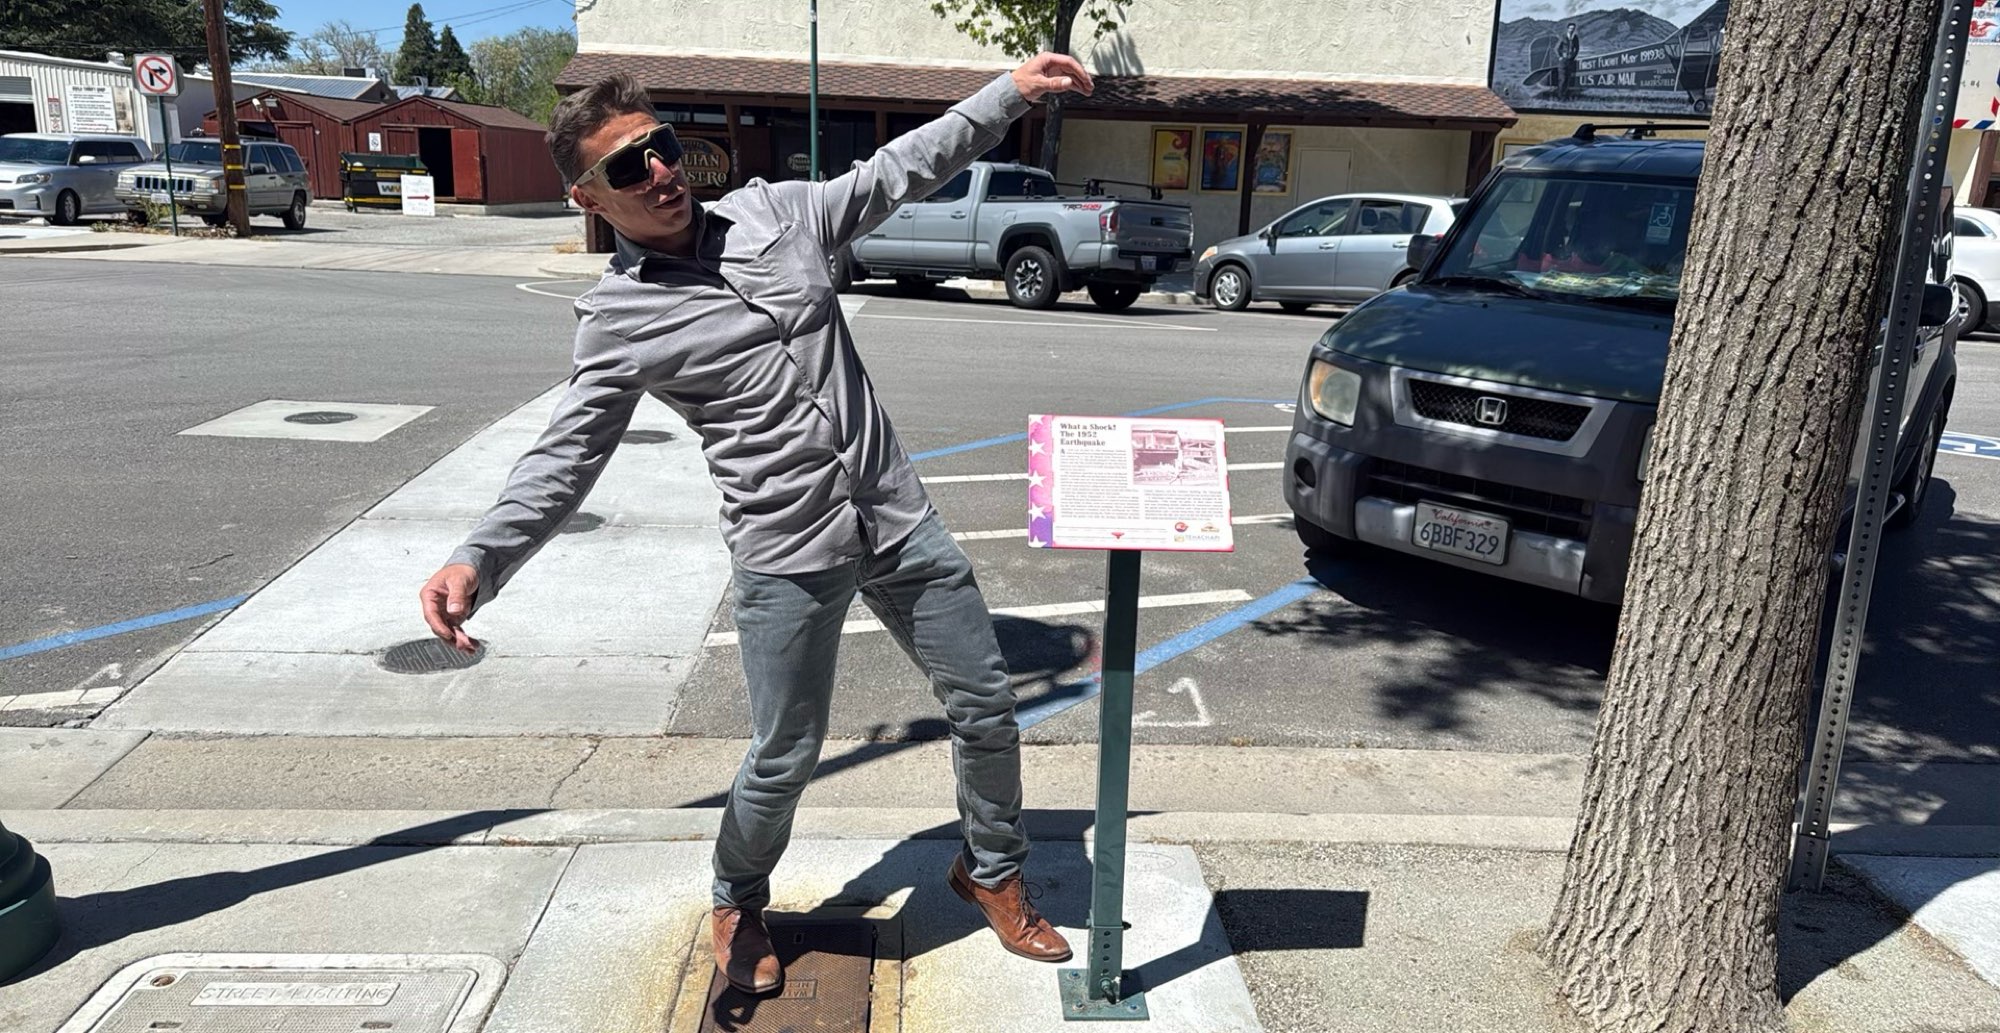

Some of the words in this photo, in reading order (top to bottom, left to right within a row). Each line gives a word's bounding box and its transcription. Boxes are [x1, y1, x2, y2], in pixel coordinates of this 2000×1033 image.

[687, 171, 727, 187] STRO
[1060, 439, 1106, 447] Earthquake
[1432, 508, 1492, 528] California
[1420, 521, 1499, 555] 6BBF329
[200, 987, 277, 999] STREET
[290, 987, 391, 999] LIGHTING
